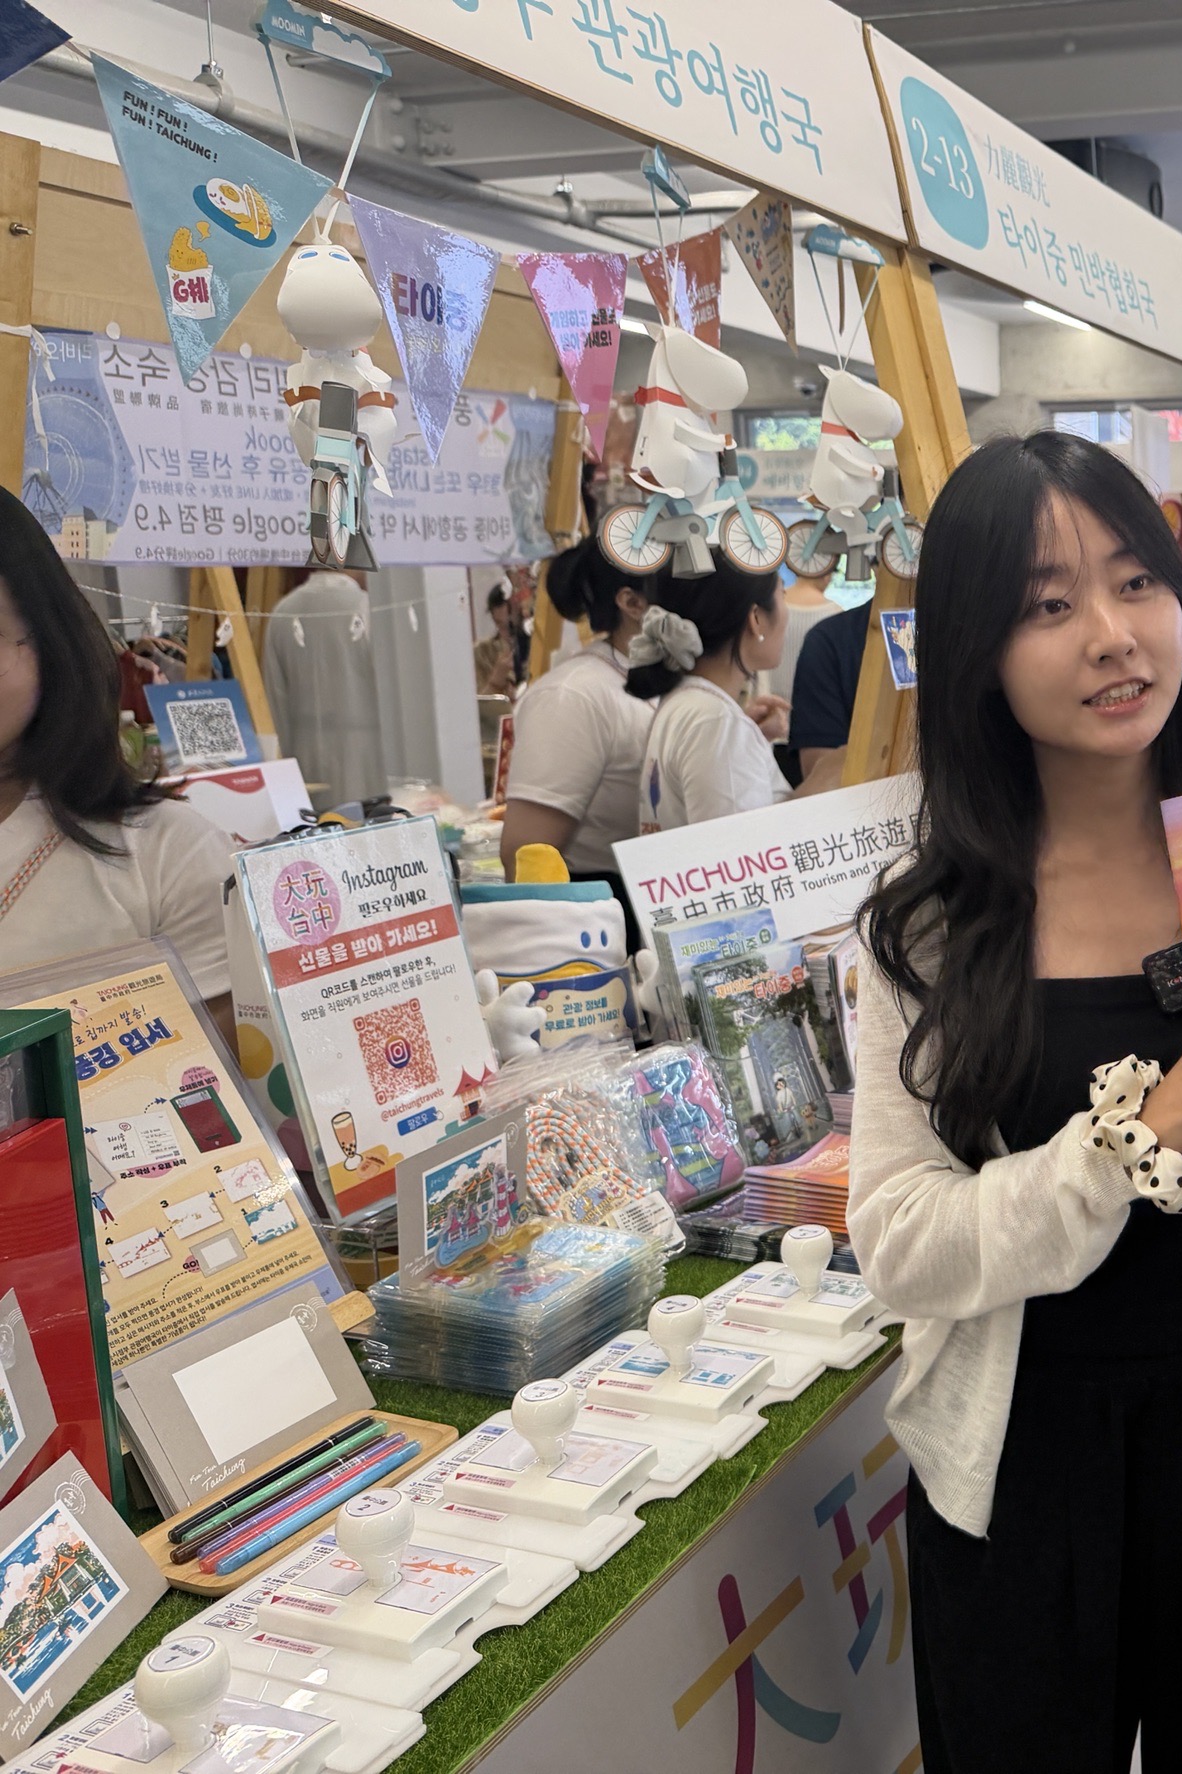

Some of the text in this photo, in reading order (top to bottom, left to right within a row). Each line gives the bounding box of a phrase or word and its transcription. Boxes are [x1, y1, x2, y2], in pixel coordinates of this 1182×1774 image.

[911, 117, 974, 200] 2-13
[997, 203, 1068, 288] 타이중
[280, 869, 328, 906] 大玩
[341, 860, 429, 895] Instagram
[639, 845, 788, 904] TAICHUNG
[801, 871, 848, 892] Tourism
[850, 863, 870, 878] and
[870, 856, 903, 875] Trav
[287, 902, 333, 938] 台中
[298, 919, 438, 974] 선물을 받아 가세요!
[86, 1004, 147, 1041] 집까지 발송!
[118, 1016, 174, 1056] 엽서
[213, 1165, 222, 1174] 2
[160, 1200, 169, 1208] 3
[104, 1237, 114, 1246] 4
[201, 1458, 246, 1492] Taichung
[11, 1688, 54, 1740] Taichung
